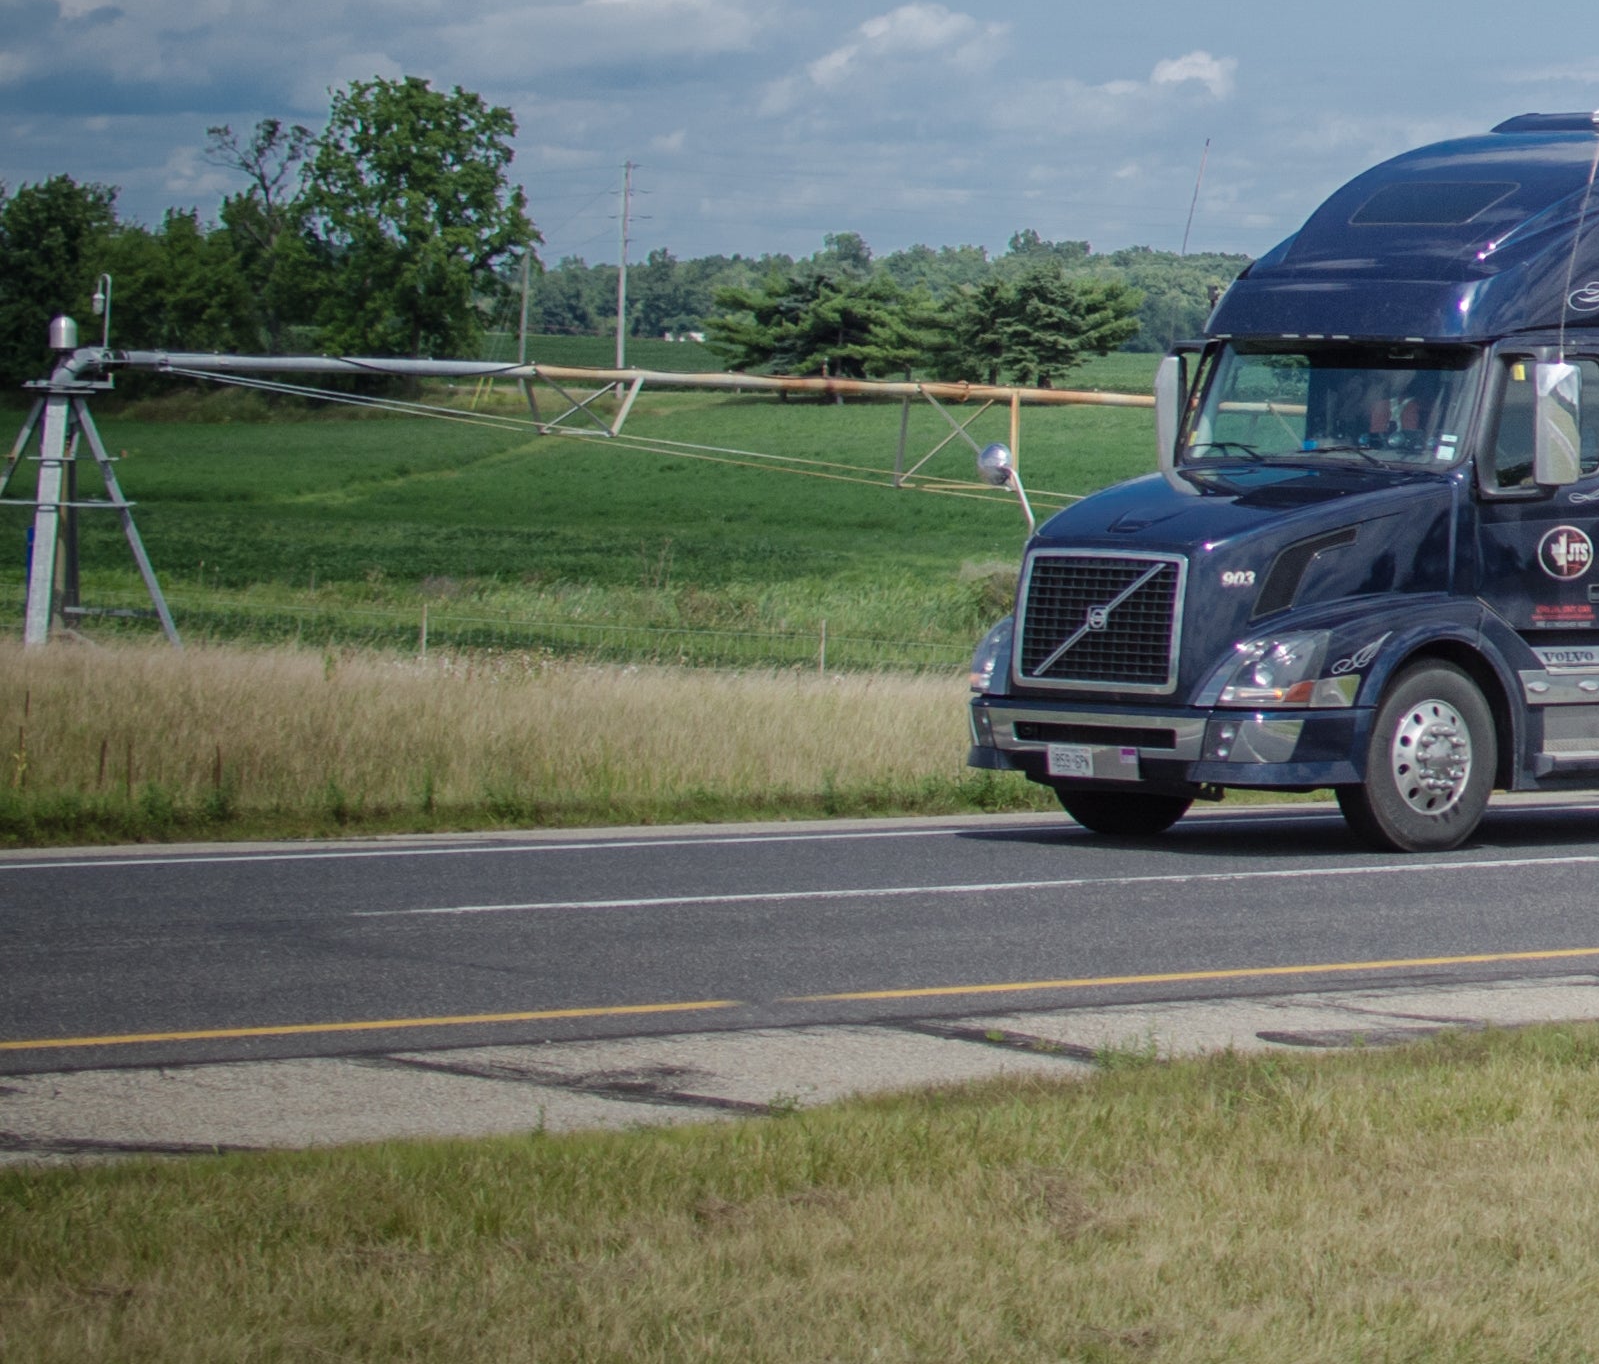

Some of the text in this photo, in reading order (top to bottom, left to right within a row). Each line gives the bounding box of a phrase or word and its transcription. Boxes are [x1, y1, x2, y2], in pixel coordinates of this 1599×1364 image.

[1567, 542, 1589, 562] JTS
[1222, 570, 1257, 587] 903
[1542, 651, 1595, 662] VOLVO
